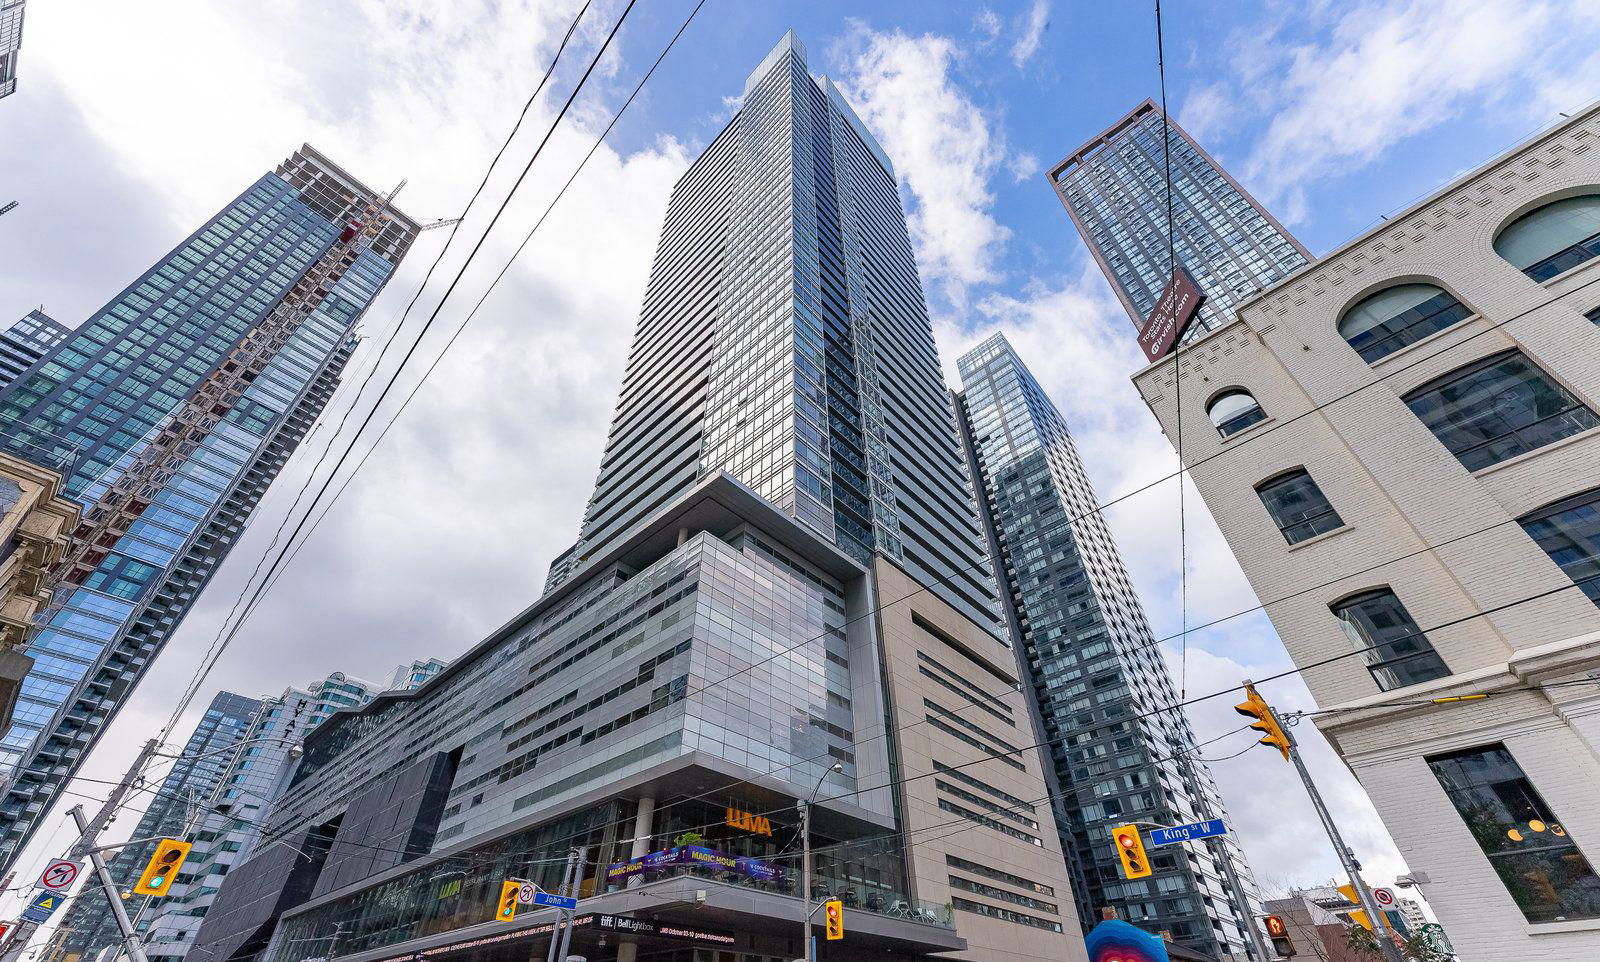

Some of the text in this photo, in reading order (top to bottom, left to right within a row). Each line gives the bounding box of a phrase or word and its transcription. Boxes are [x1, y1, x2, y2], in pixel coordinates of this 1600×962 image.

[1141, 313, 1162, 343] Toronto
[1151, 293, 1189, 355] mirvishcom
[1151, 315, 1166, 340] Starts
[726, 807, 772, 837] LUMA
[1163, 828, 1190, 840] King
[1200, 822, 1211, 833] W
[692, 850, 715, 863] MAGIC
[715, 856, 736, 868] HOUR
[545, 895, 562, 905] John
